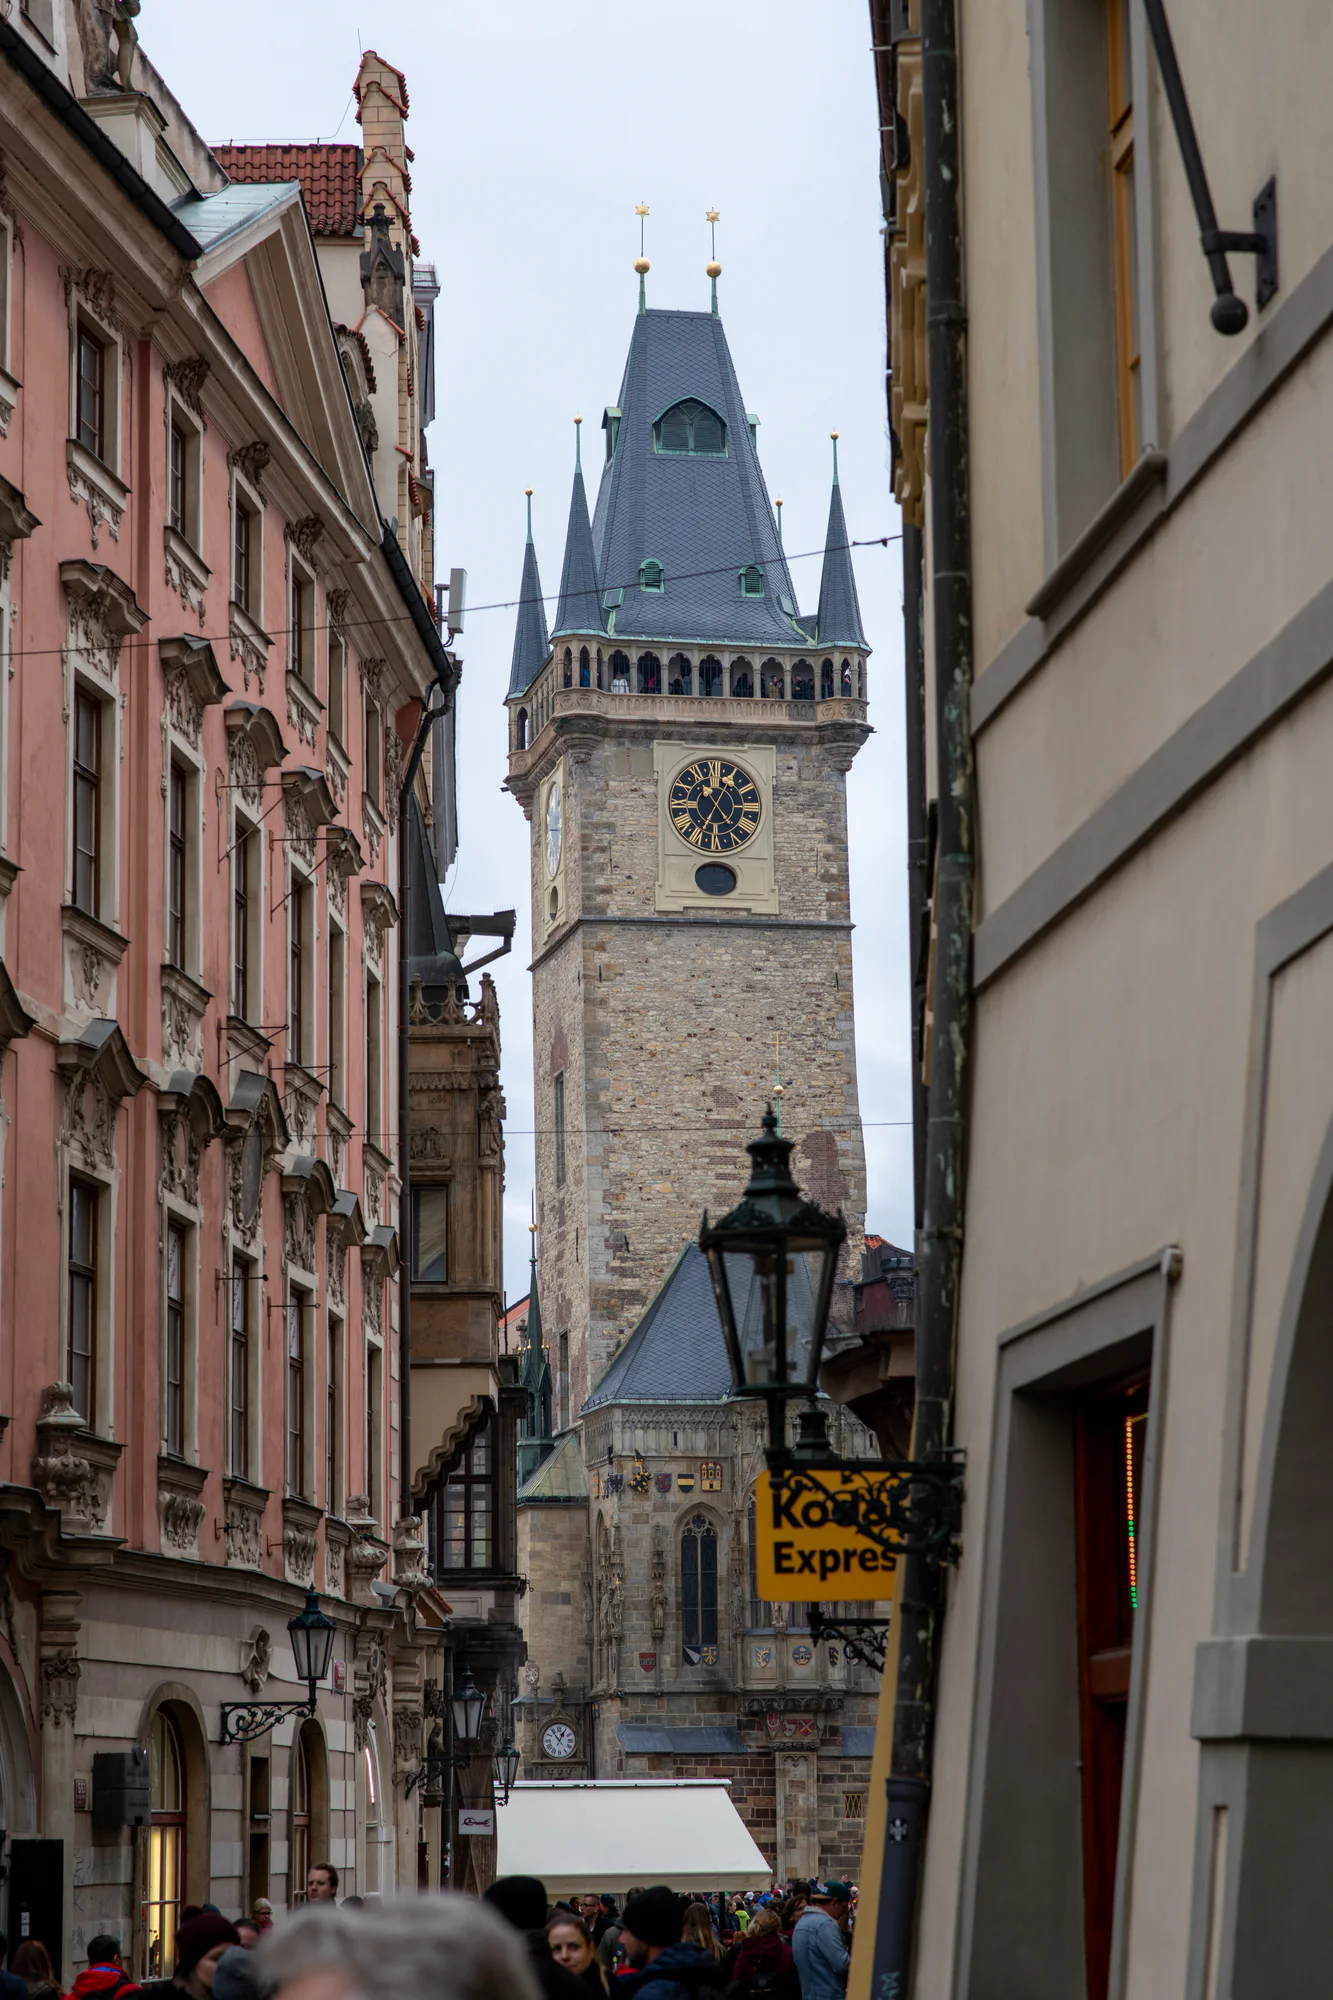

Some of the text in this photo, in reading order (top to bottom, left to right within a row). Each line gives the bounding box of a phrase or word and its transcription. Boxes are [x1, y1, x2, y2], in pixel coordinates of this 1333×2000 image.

[708, 761, 721, 777] XII
[744, 802, 759, 812] III
[773, 1480, 905, 1528] Koda
[774, 1541, 896, 1581] Expres
